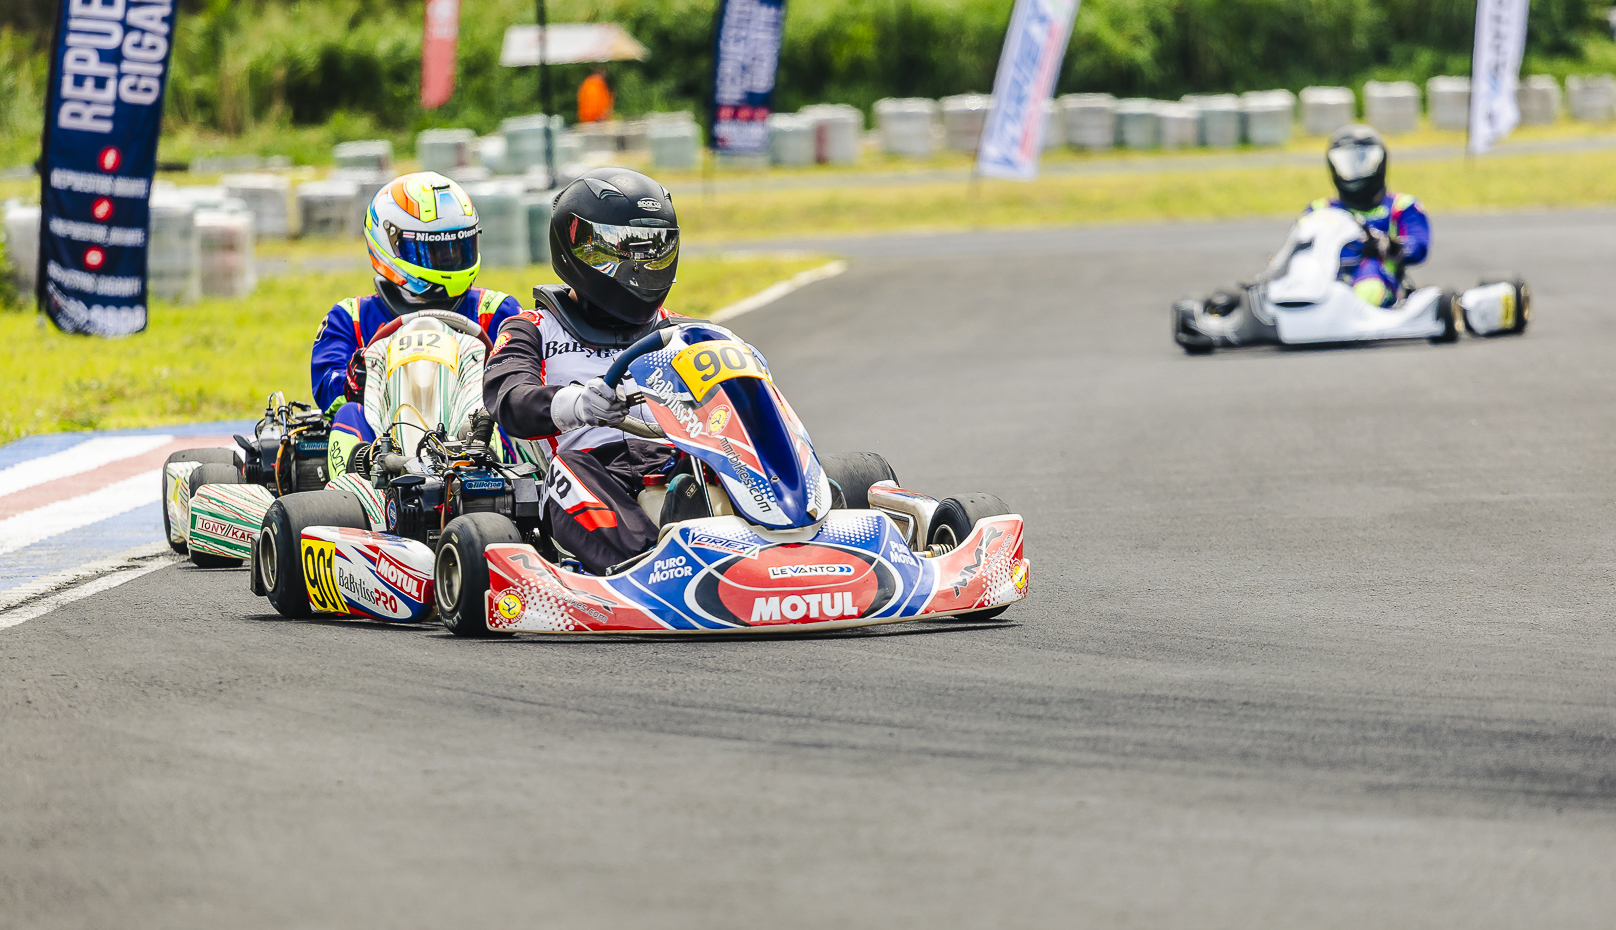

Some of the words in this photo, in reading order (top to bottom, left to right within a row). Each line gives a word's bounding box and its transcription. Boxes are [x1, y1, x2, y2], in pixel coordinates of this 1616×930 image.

[415, 231, 456, 242] Nicolás
[398, 333, 441, 351] 912
[693, 347, 764, 382] 901
[718, 437, 772, 513] mmrbikes.com
[200, 518, 227, 535] TONY
[690, 531, 752, 552] VORTEX
[653, 555, 687, 572] PURO
[772, 565, 836, 576] LEVANTO
[304, 545, 348, 610] 901
[377, 557, 420, 598] MOTUL
[648, 566, 693, 585] MOTOR
[750, 591, 859, 622] MOTUL
